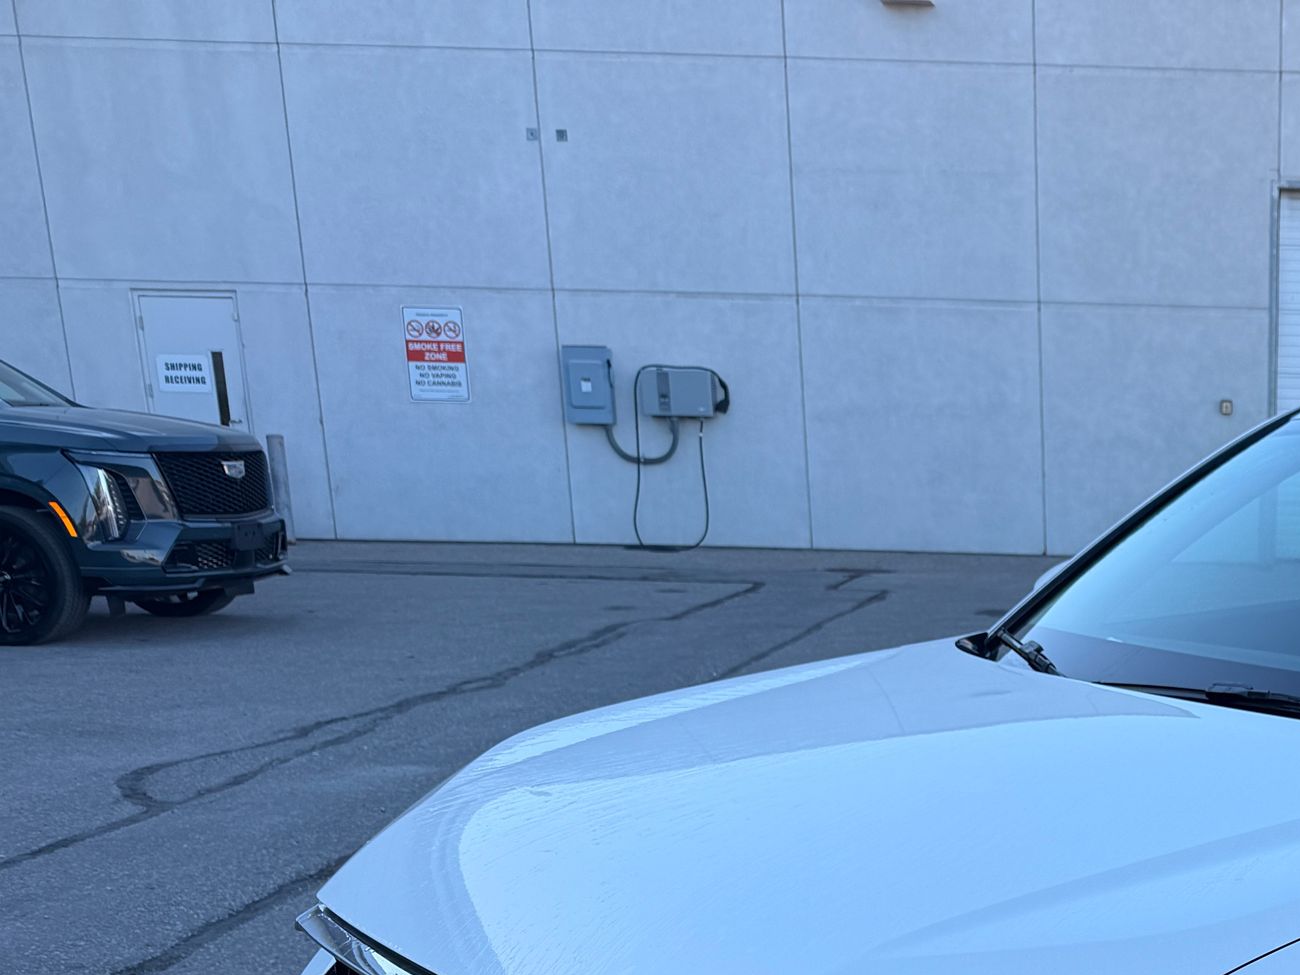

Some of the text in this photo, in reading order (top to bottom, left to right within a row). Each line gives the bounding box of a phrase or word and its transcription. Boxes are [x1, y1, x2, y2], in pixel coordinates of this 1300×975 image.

[408, 342, 463, 352] SMOKE FREE
[424, 352, 448, 361] ZONE
[164, 362, 203, 372] SHIPPING
[164, 375, 207, 385] RECEIVING
